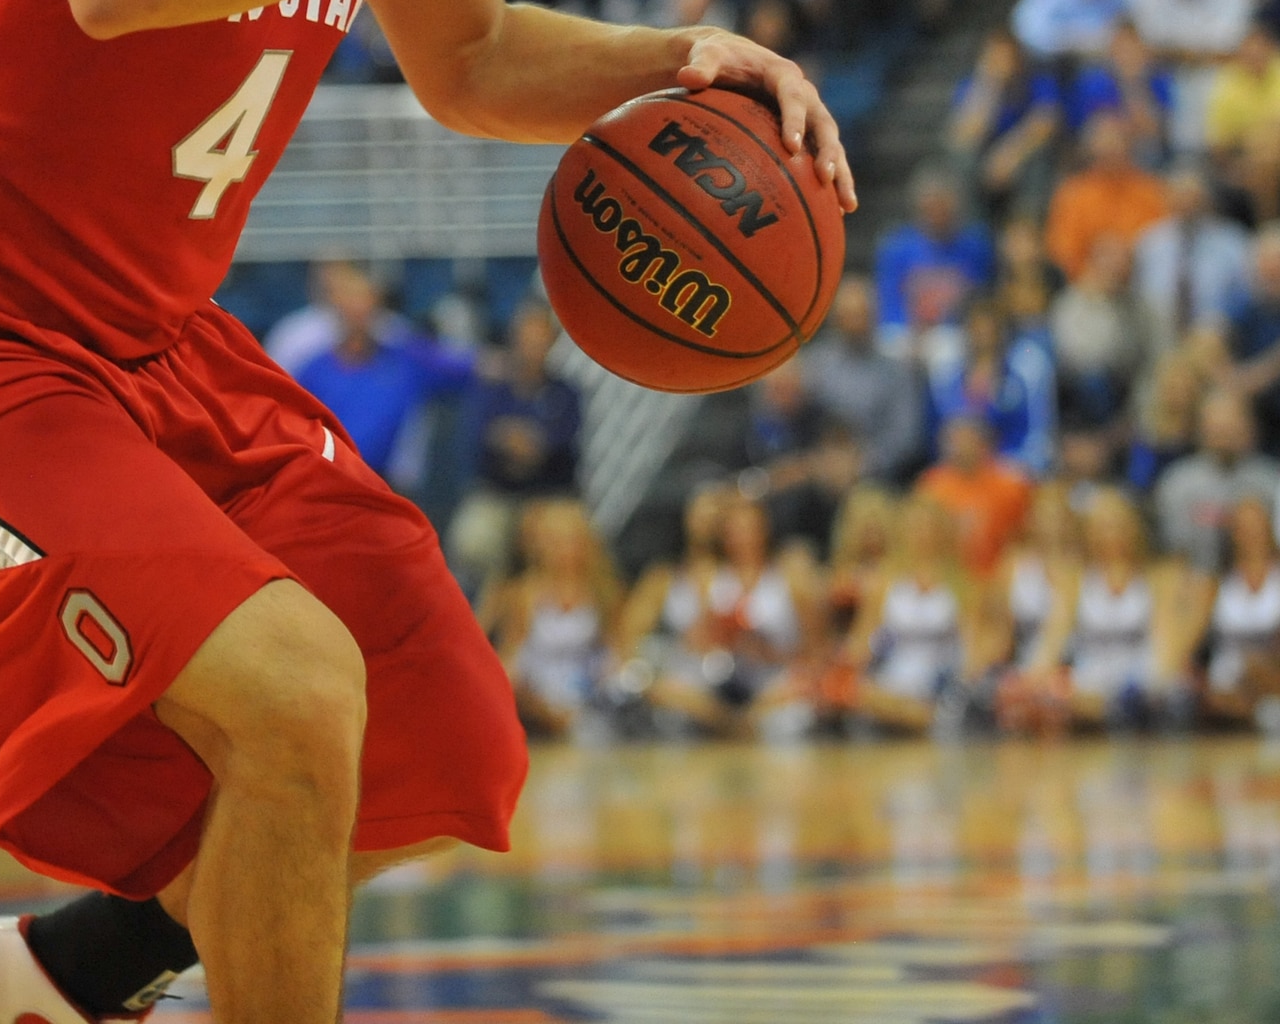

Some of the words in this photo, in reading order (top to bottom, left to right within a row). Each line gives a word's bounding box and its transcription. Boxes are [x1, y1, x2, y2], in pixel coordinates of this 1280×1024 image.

[171, 48, 294, 220] 4
[647, 120, 779, 239] NCAA
[573, 167, 732, 339] Wilson
